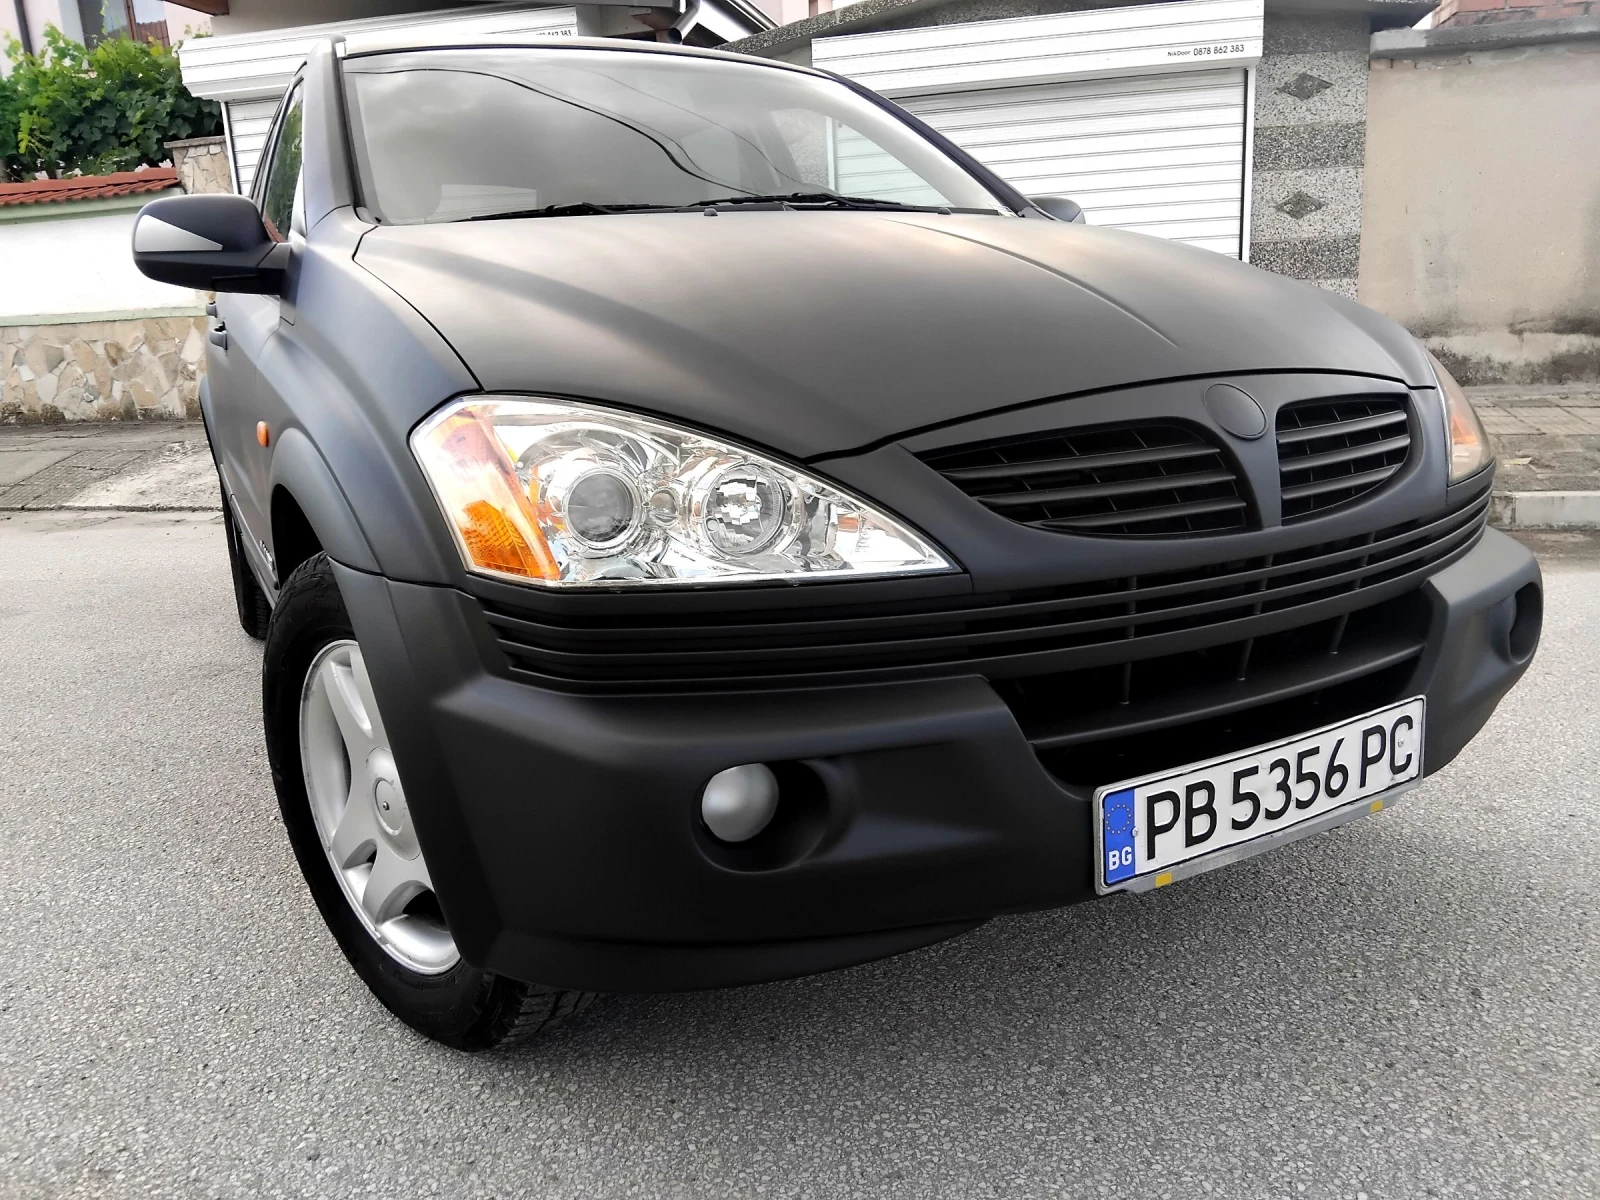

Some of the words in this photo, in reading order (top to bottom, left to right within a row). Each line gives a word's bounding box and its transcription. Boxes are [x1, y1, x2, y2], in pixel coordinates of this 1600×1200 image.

[1193, 47, 1212, 56] 0878
[1213, 45, 1228, 54] 862
[1230, 44, 1244, 53] 383
[1146, 780, 1218, 861] PB
[1231, 737, 1349, 831] 5356
[1359, 714, 1414, 789] PC
[1108, 846, 1133, 871] BG
